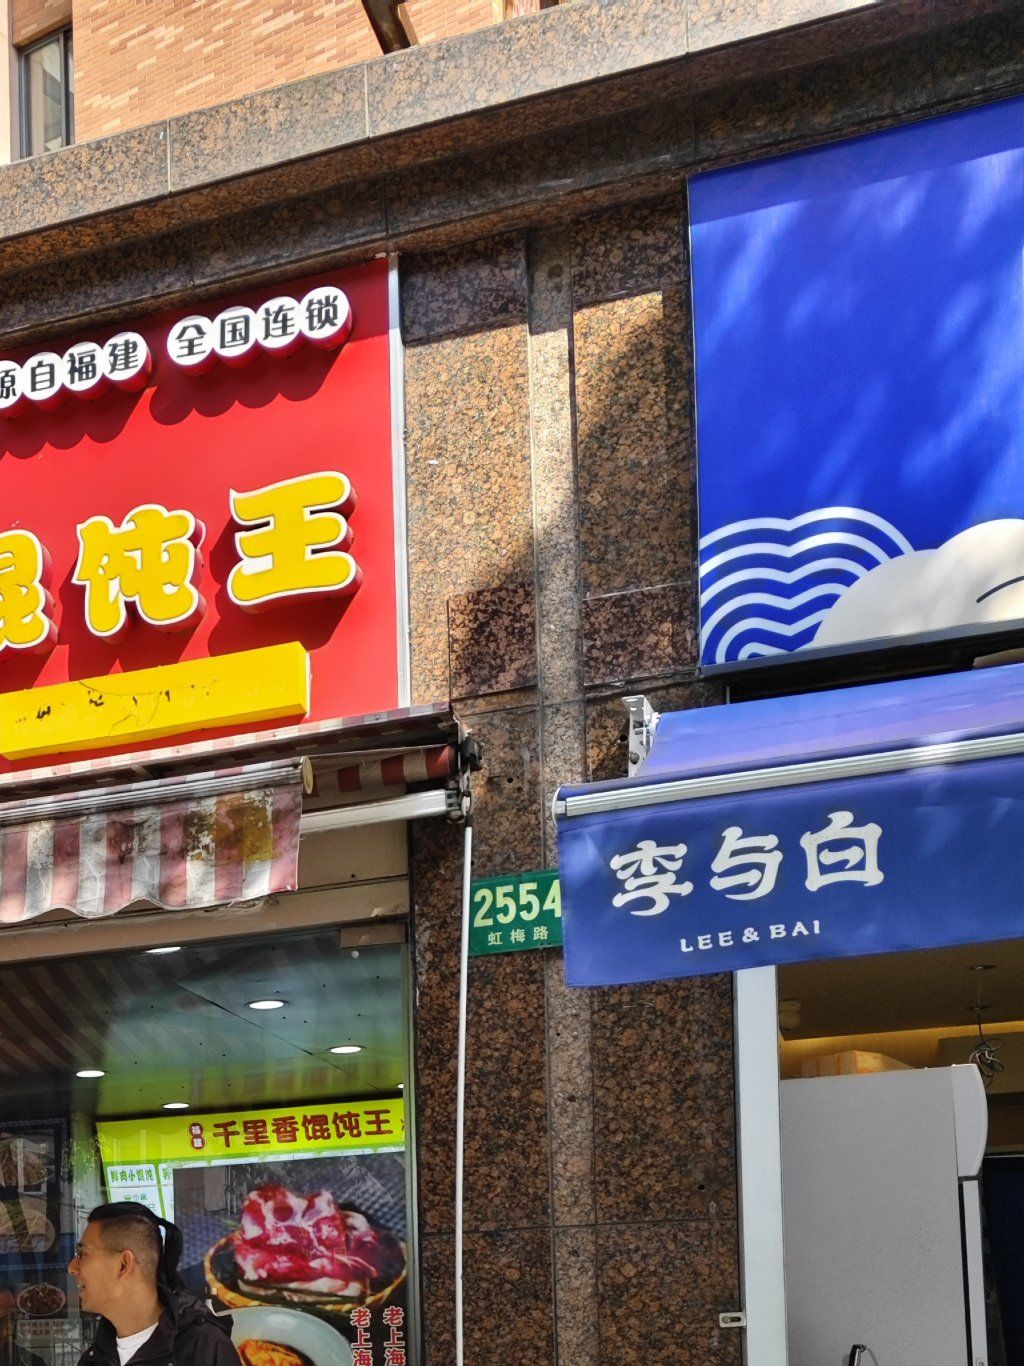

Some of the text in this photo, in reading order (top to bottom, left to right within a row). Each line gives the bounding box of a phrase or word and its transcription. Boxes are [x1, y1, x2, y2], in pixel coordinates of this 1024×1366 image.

[174, 294, 340, 360] 全国连锁
[609, 810, 885, 917] 李与白
[473, 879, 562, 928] 2554
[487, 926, 549, 947] 虹梅路
[679, 919, 822, 953] LEE & BAI
[212, 1109, 394, 1148] 千里香馄饨王
